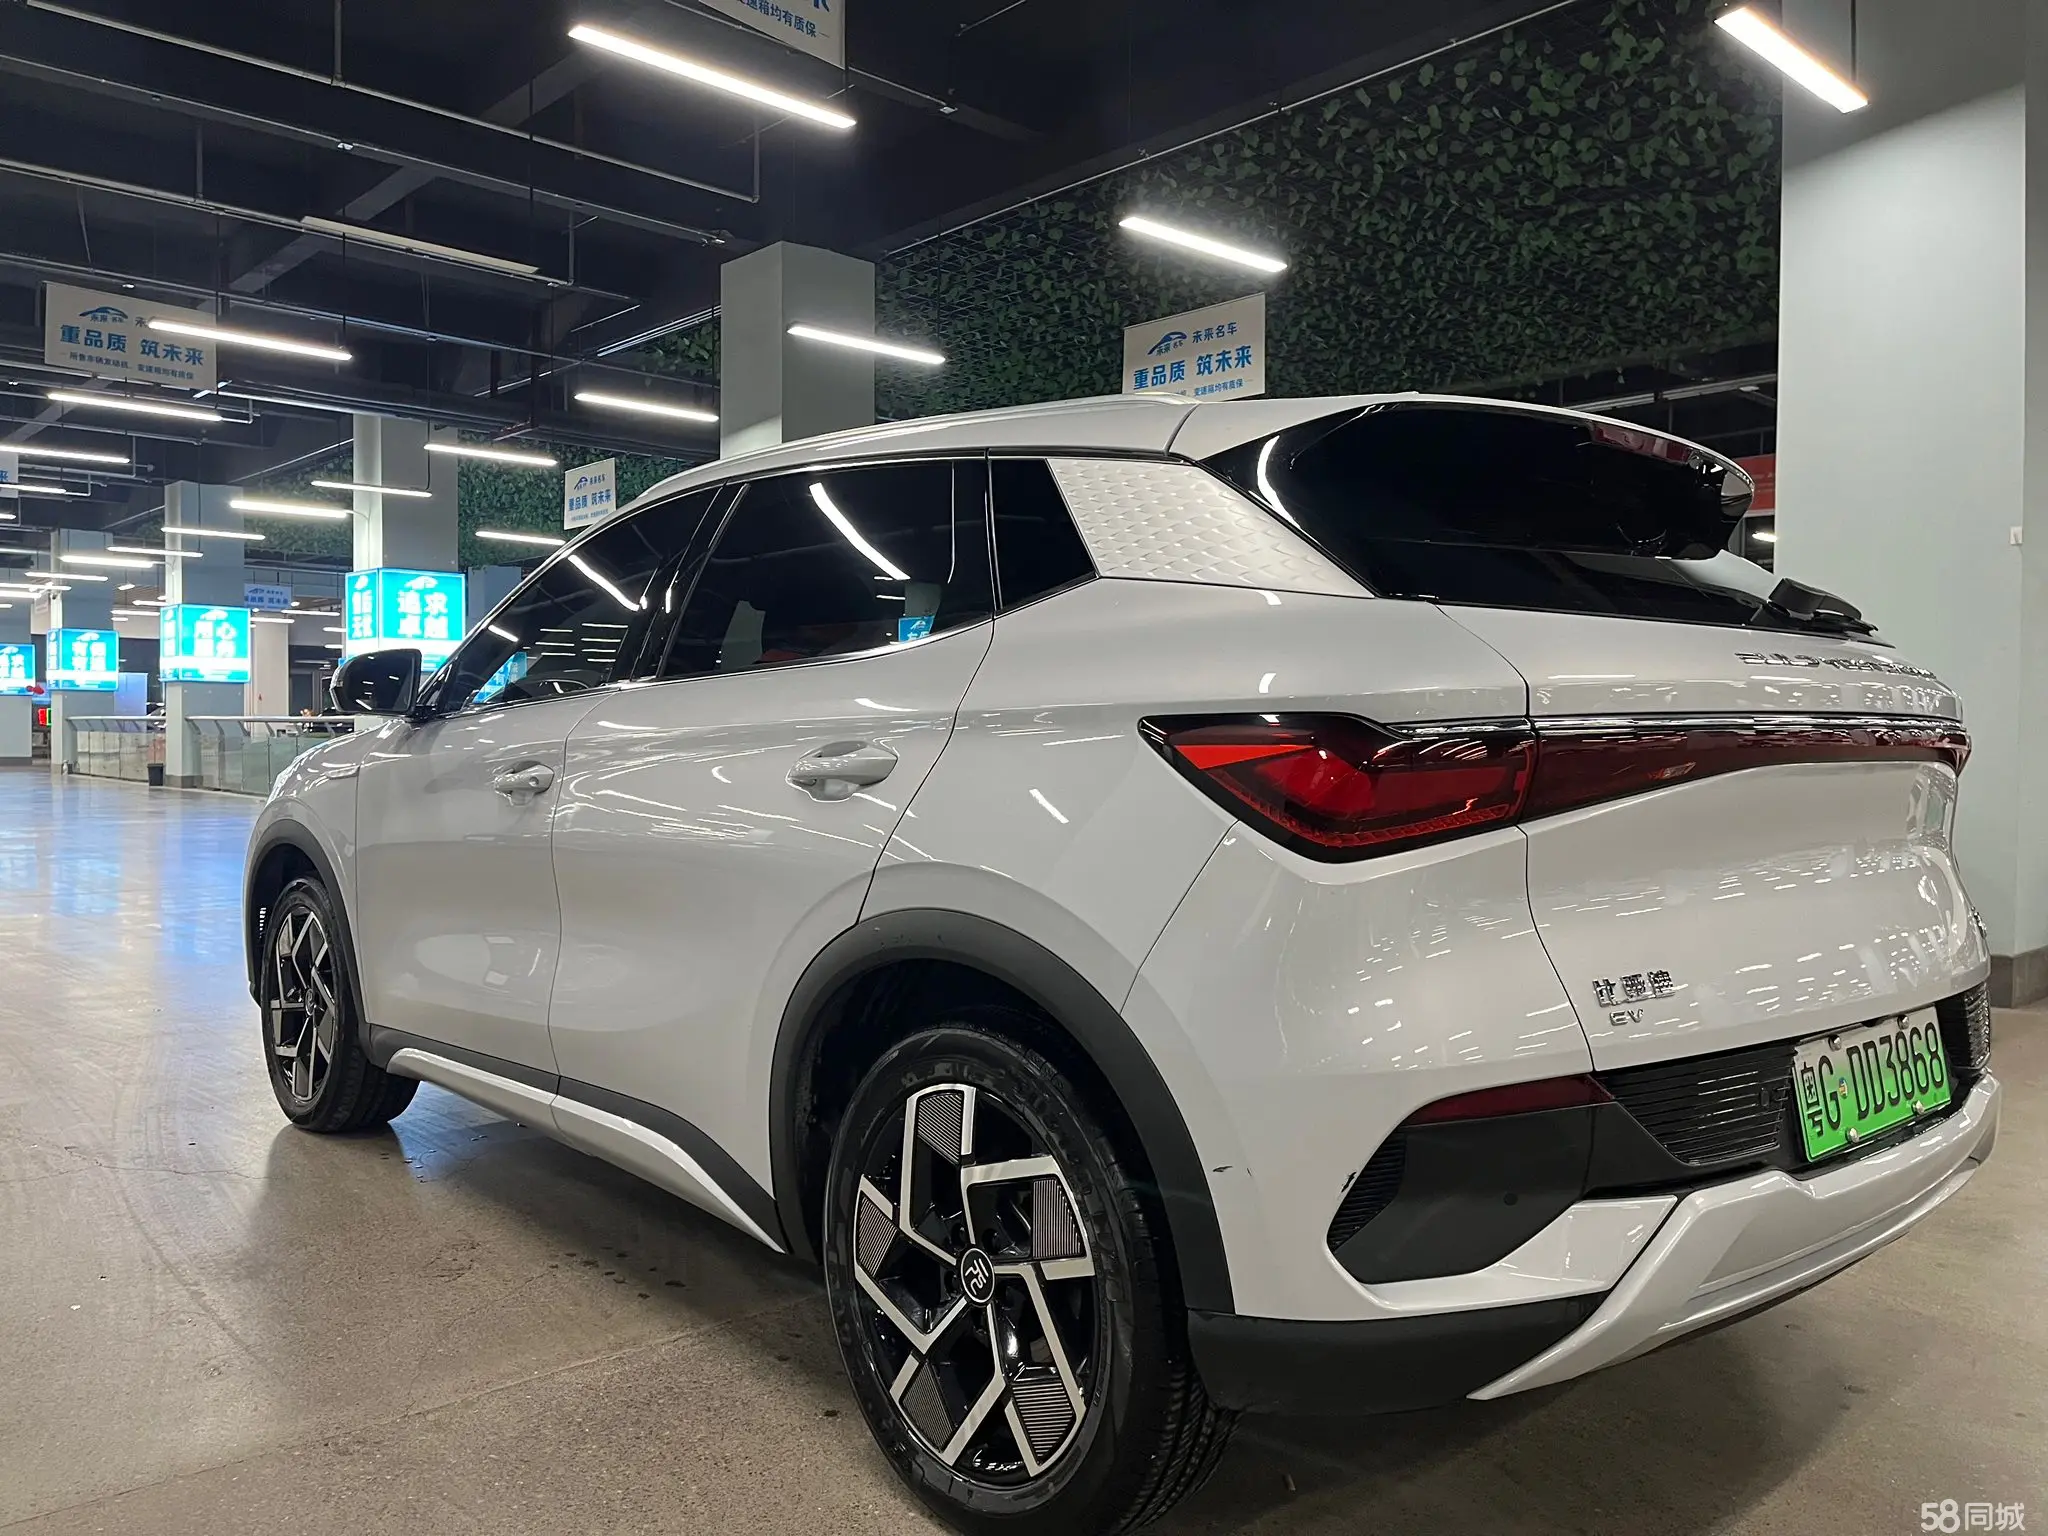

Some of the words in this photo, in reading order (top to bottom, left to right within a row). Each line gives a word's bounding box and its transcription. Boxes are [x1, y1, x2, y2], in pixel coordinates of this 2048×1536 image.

[741, 0, 816, 38] 速箱均有质保
[60, 324, 127, 353] 重品质
[140, 339, 204, 366] 筑未来
[1192, 321, 1238, 344] 未来名车
[1133, 360, 1186, 390] 重品质
[1196, 345, 1251, 377] 筑未来
[1609, 1008, 1644, 1026] EV
